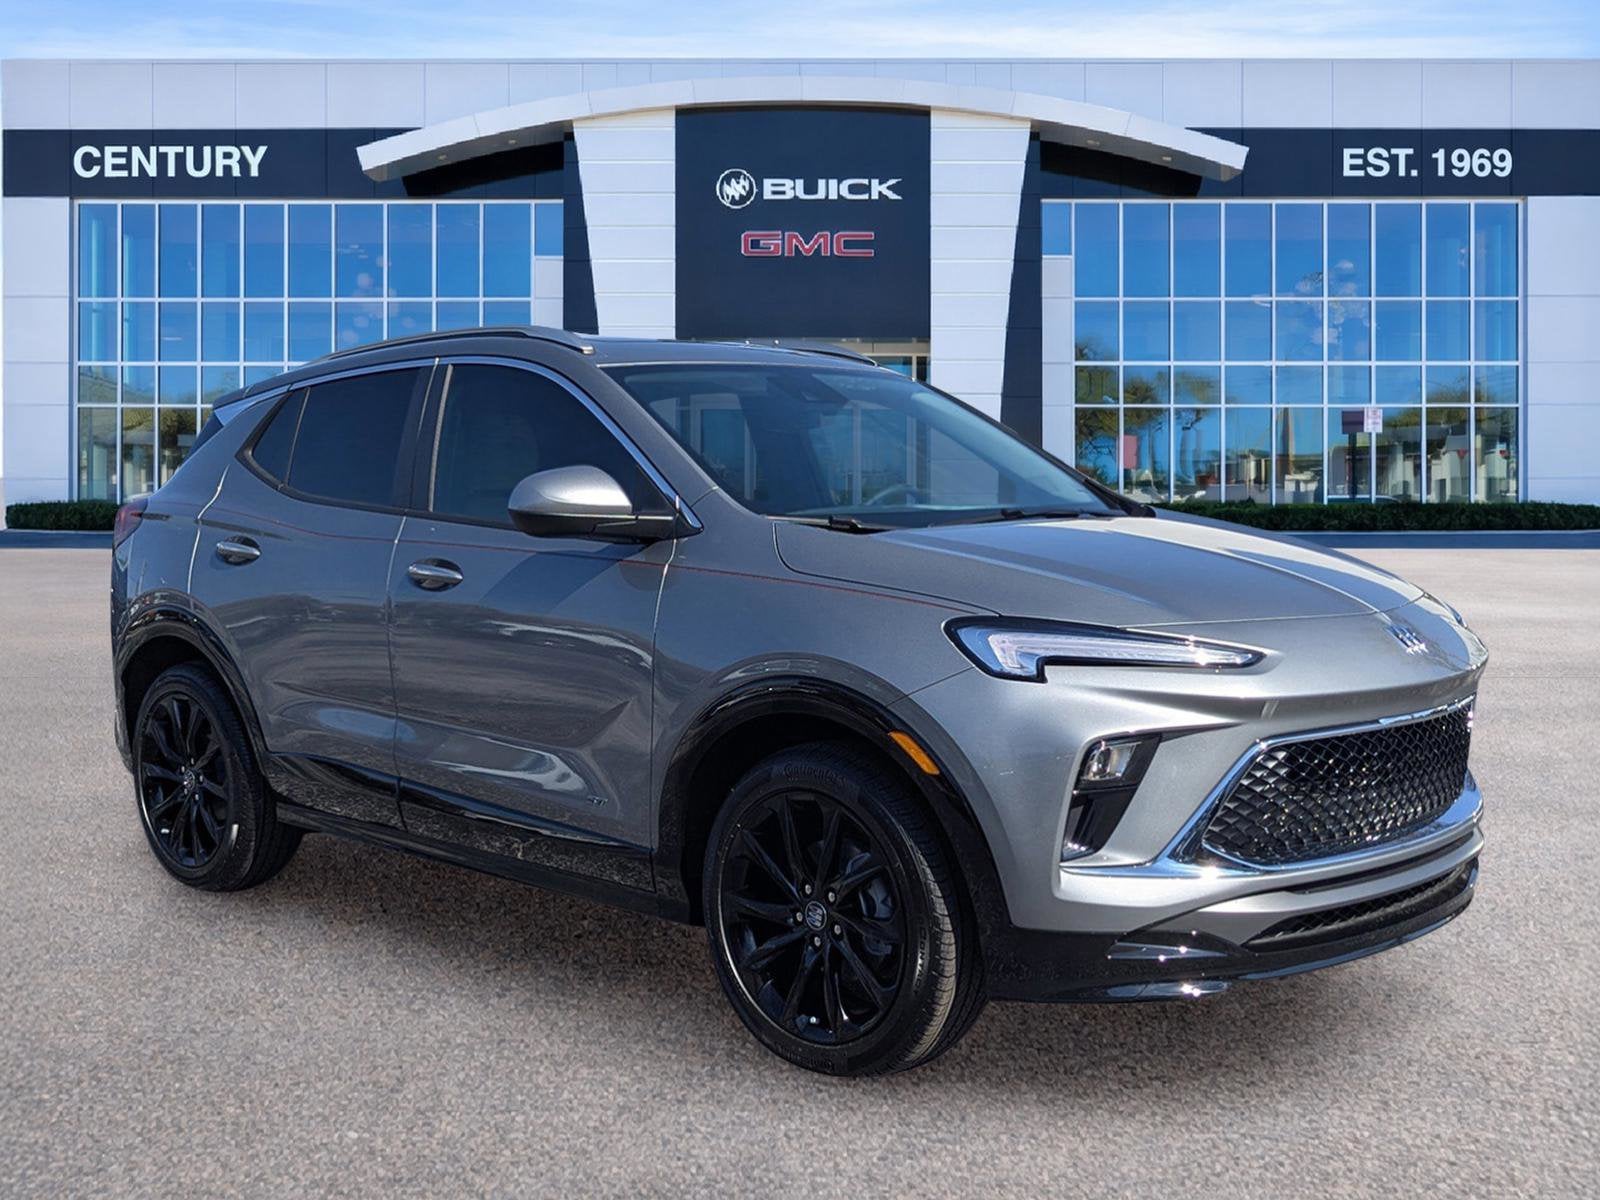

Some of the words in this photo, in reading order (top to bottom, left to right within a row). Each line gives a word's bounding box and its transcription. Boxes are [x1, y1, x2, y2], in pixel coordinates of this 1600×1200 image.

[73, 145, 268, 178] CENTURY
[1342, 147, 1418, 177] EST.
[1431, 148, 1513, 177] 1969
[762, 178, 903, 200] BUICK
[740, 231, 875, 257] GMC
